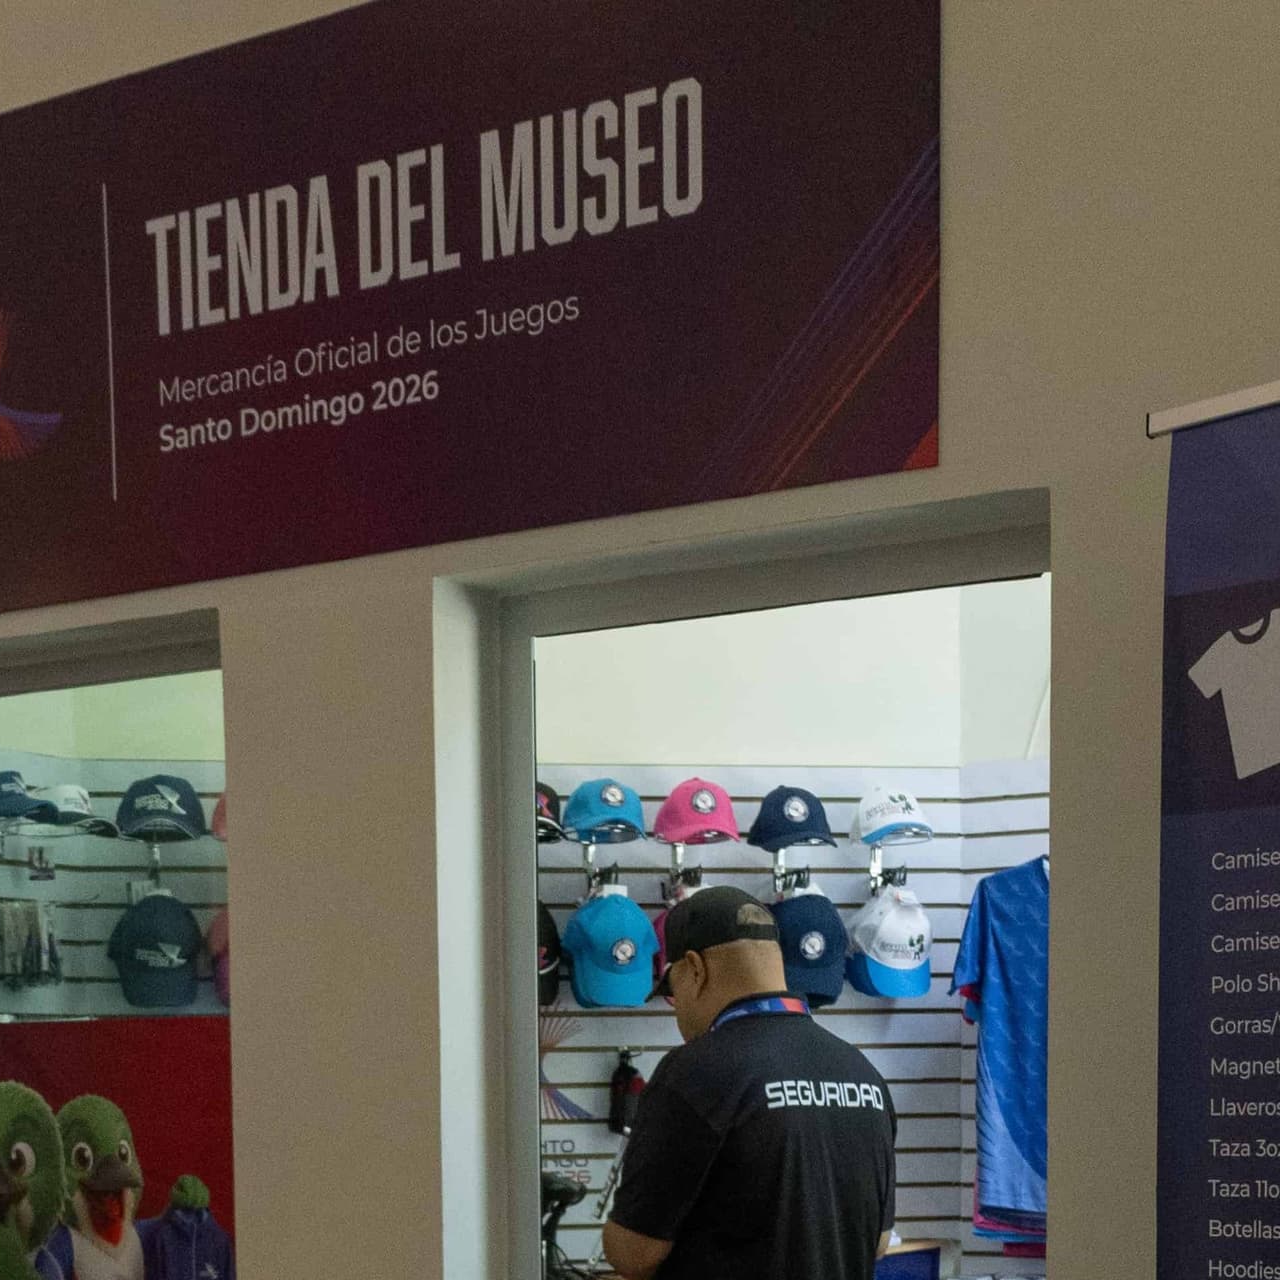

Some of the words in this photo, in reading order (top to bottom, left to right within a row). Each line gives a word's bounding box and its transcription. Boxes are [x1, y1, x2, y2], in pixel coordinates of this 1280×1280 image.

[145, 174, 340, 337] TIENDA
[357, 143, 461, 290] DEL
[479, 77, 702, 261] MUSEO
[159, 353, 288, 407] Mercancía
[294, 331, 379, 381] Oficial
[387, 324, 421, 358] de
[429, 318, 468, 349] los
[474, 296, 579, 342] Juegos
[159, 413, 232, 452] Santo
[240, 390, 364, 438] Domingo
[371, 371, 439, 412] 2026
[1211, 975, 1252, 994] Polo
[764, 1080, 885, 1113] SEGURIDAD
[1208, 1139, 1250, 1157] Taza
[1208, 1179, 1250, 1198] Taza
[1208, 1219, 1280, 1240] Botellas
